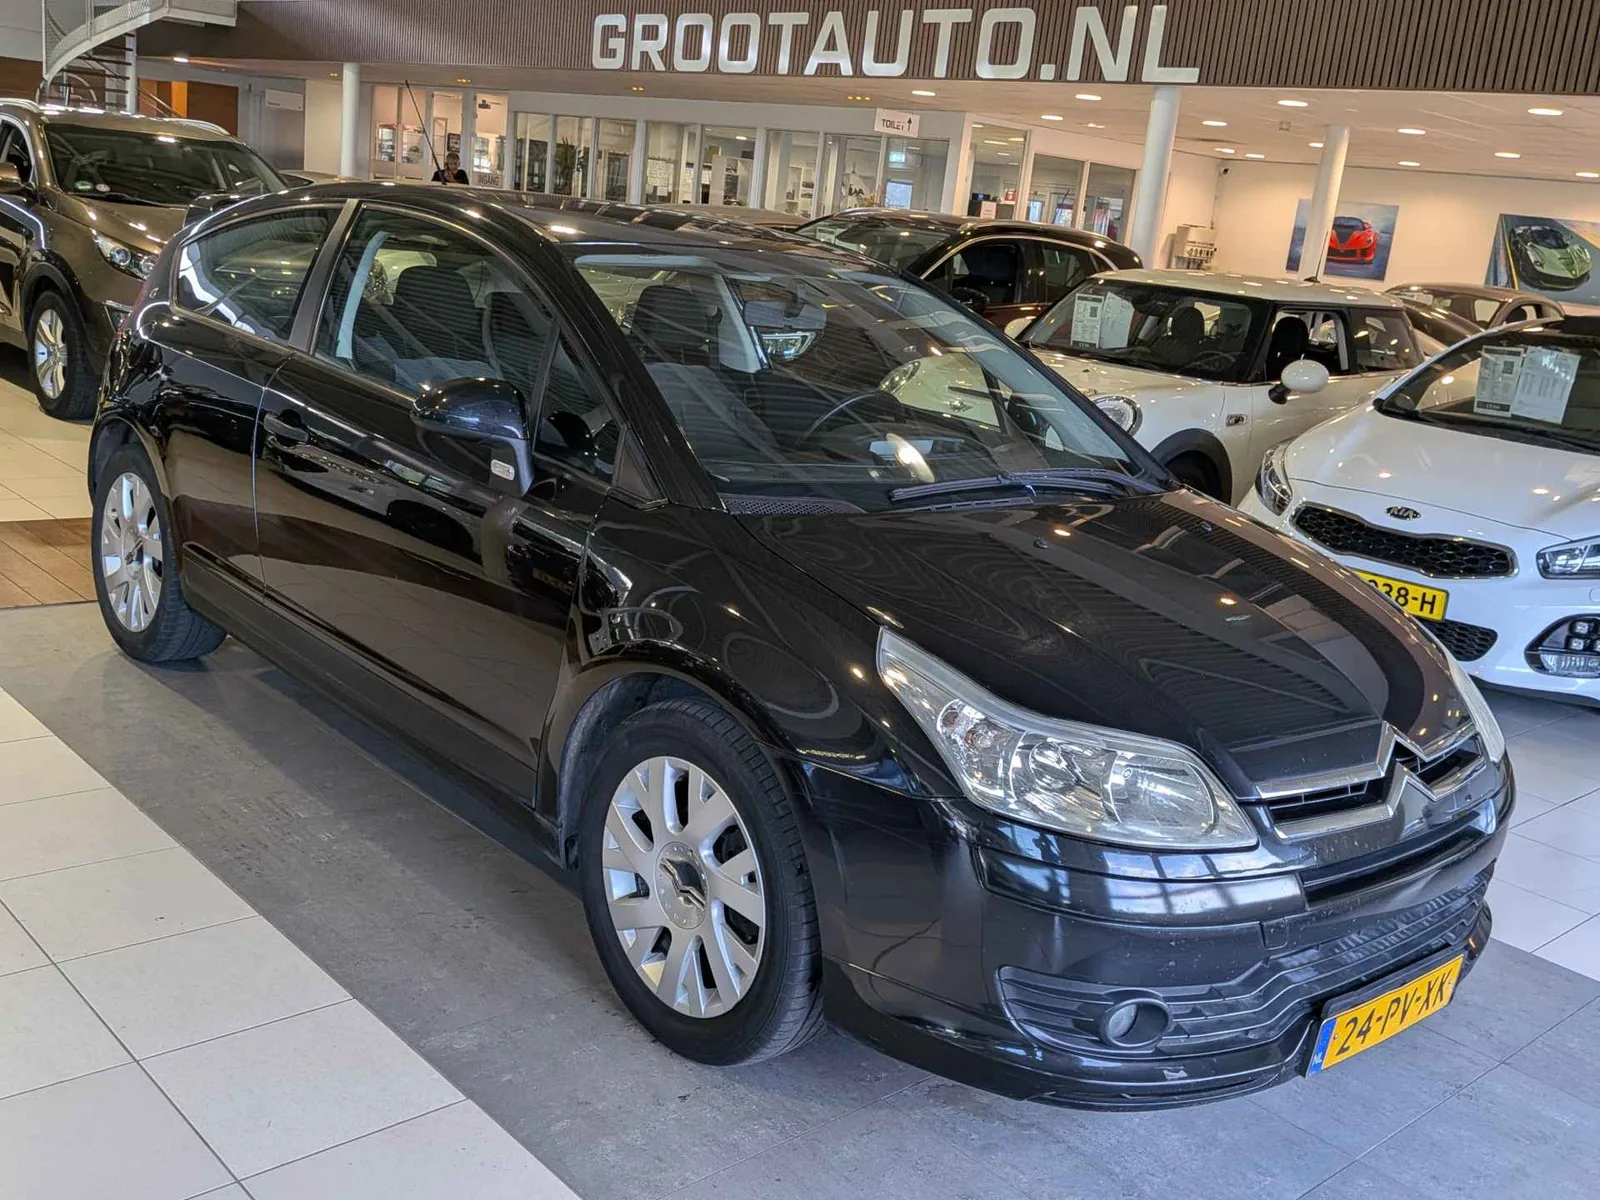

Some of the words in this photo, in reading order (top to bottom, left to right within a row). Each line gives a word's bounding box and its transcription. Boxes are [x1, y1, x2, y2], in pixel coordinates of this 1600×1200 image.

[592, 5, 1200, 83] GROOTAUTO.NL
[881, 118, 906, 131] TOILET
[1389, 506, 1417, 520] KIA
[1336, 967, 1453, 1057] 24-PV-XK
